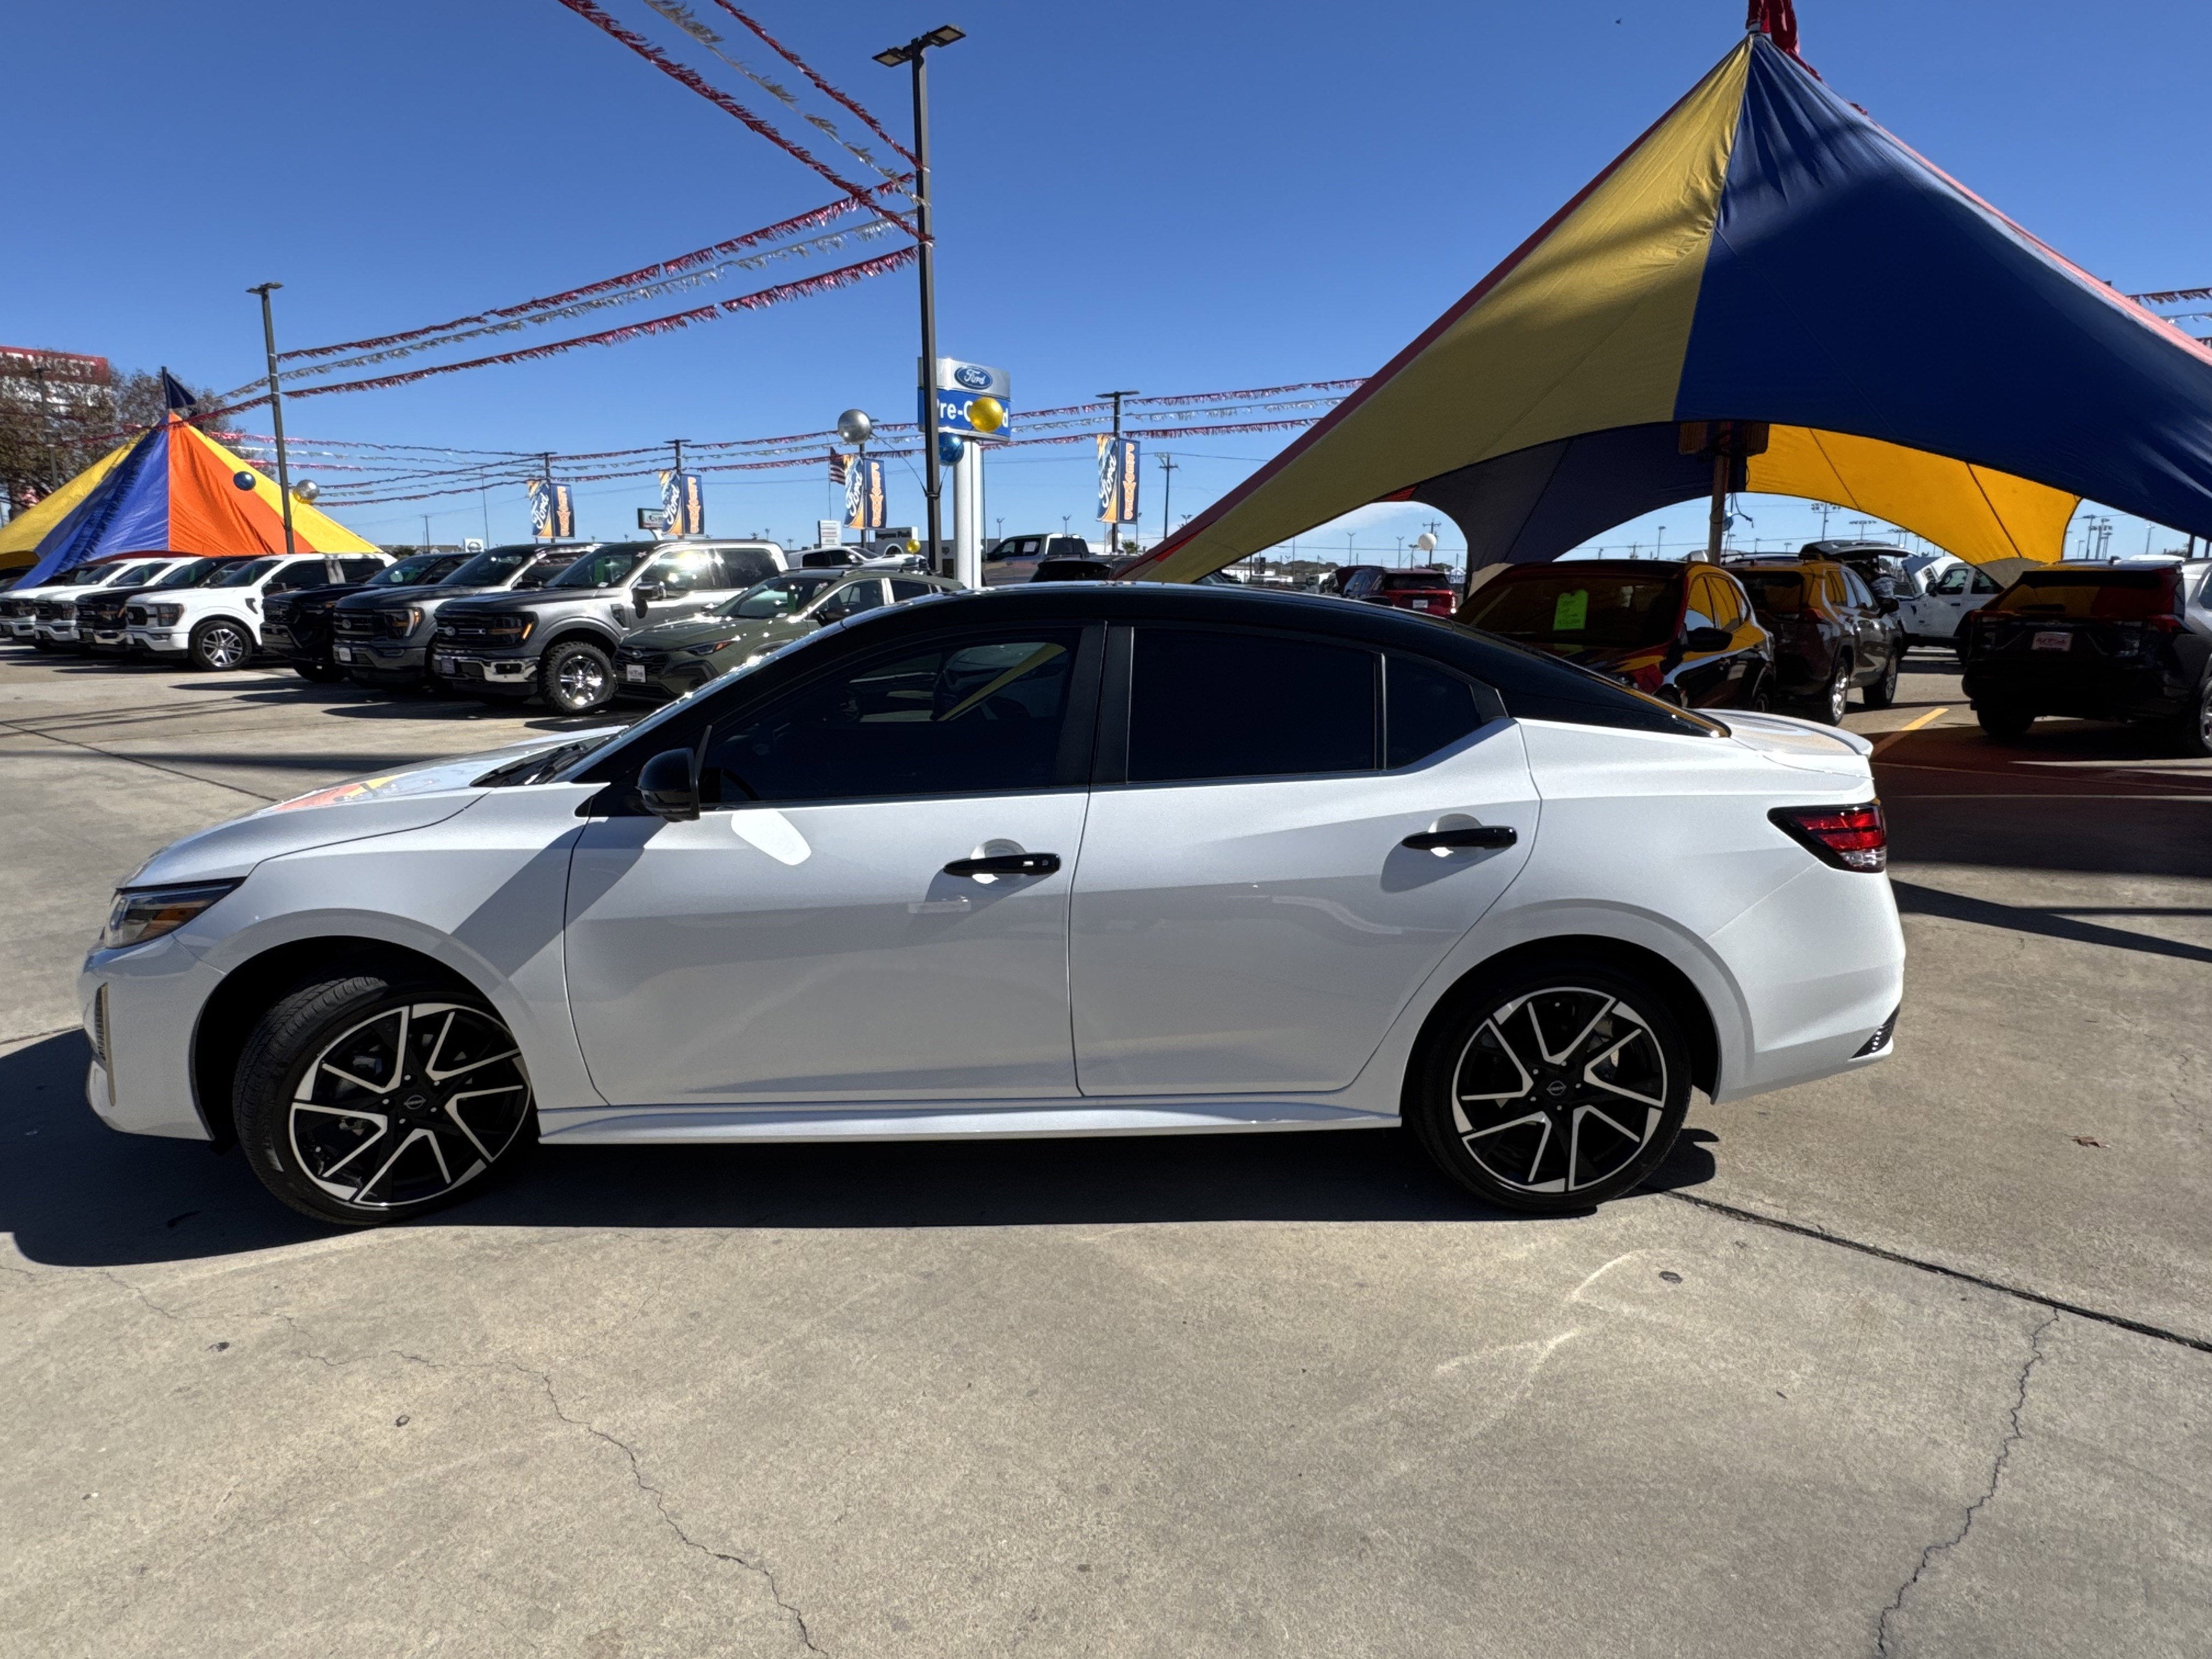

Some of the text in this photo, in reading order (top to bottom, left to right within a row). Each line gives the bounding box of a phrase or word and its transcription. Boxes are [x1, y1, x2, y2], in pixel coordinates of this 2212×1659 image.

[964, 369, 986, 385] Ford
[845, 471, 862, 517] Ford
[1099, 455, 1117, 508] Ford
[533, 492, 549, 529] Ford
[663, 483, 680, 525] Ford
